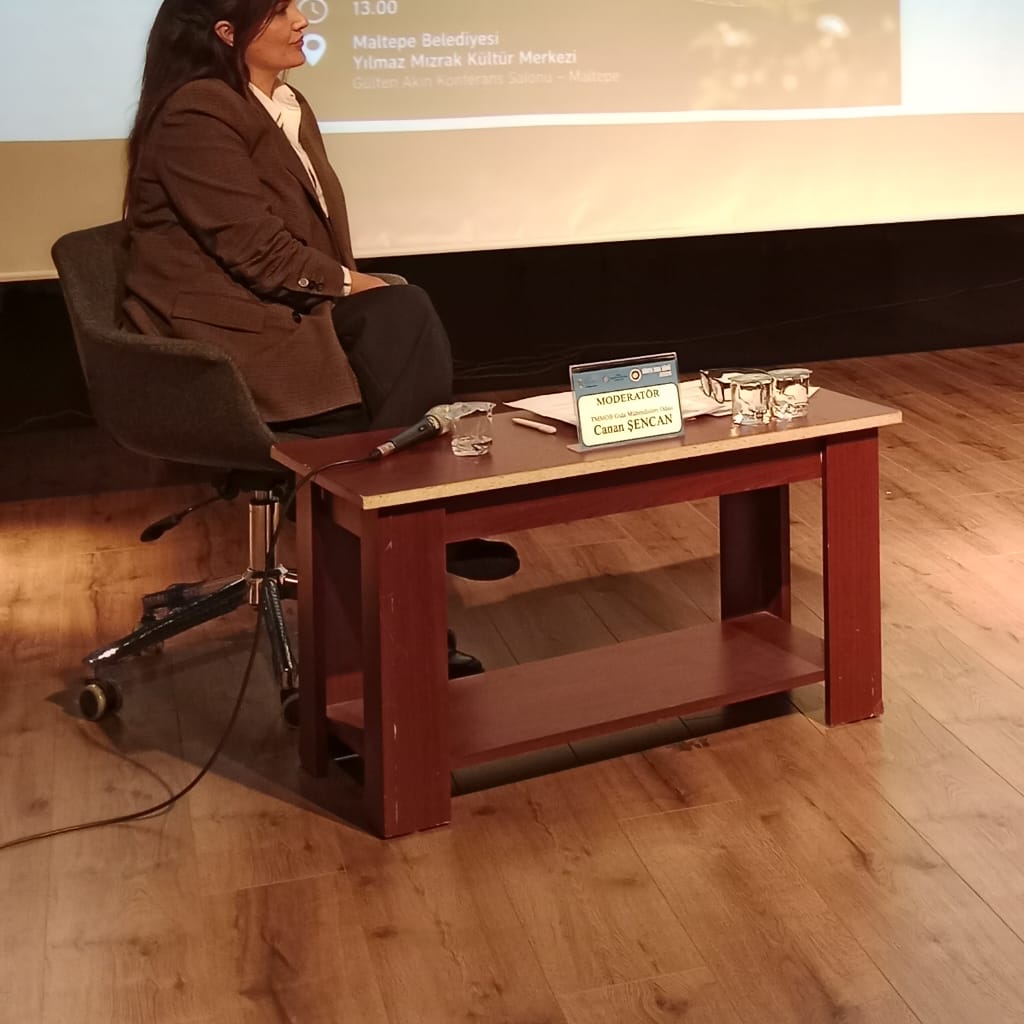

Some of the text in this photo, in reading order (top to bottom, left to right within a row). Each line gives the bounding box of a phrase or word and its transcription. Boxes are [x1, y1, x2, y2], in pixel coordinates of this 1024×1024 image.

[352, 0, 398, 15] 13.00
[352, 31, 499, 50] Maltepe Belediyesi
[352, 49, 577, 70] Yılmaz Mızrak Kültür Merkezi
[596, 389, 660, 406] MODERATÖR
[594, 413, 673, 436] Canan ŞENCAN
